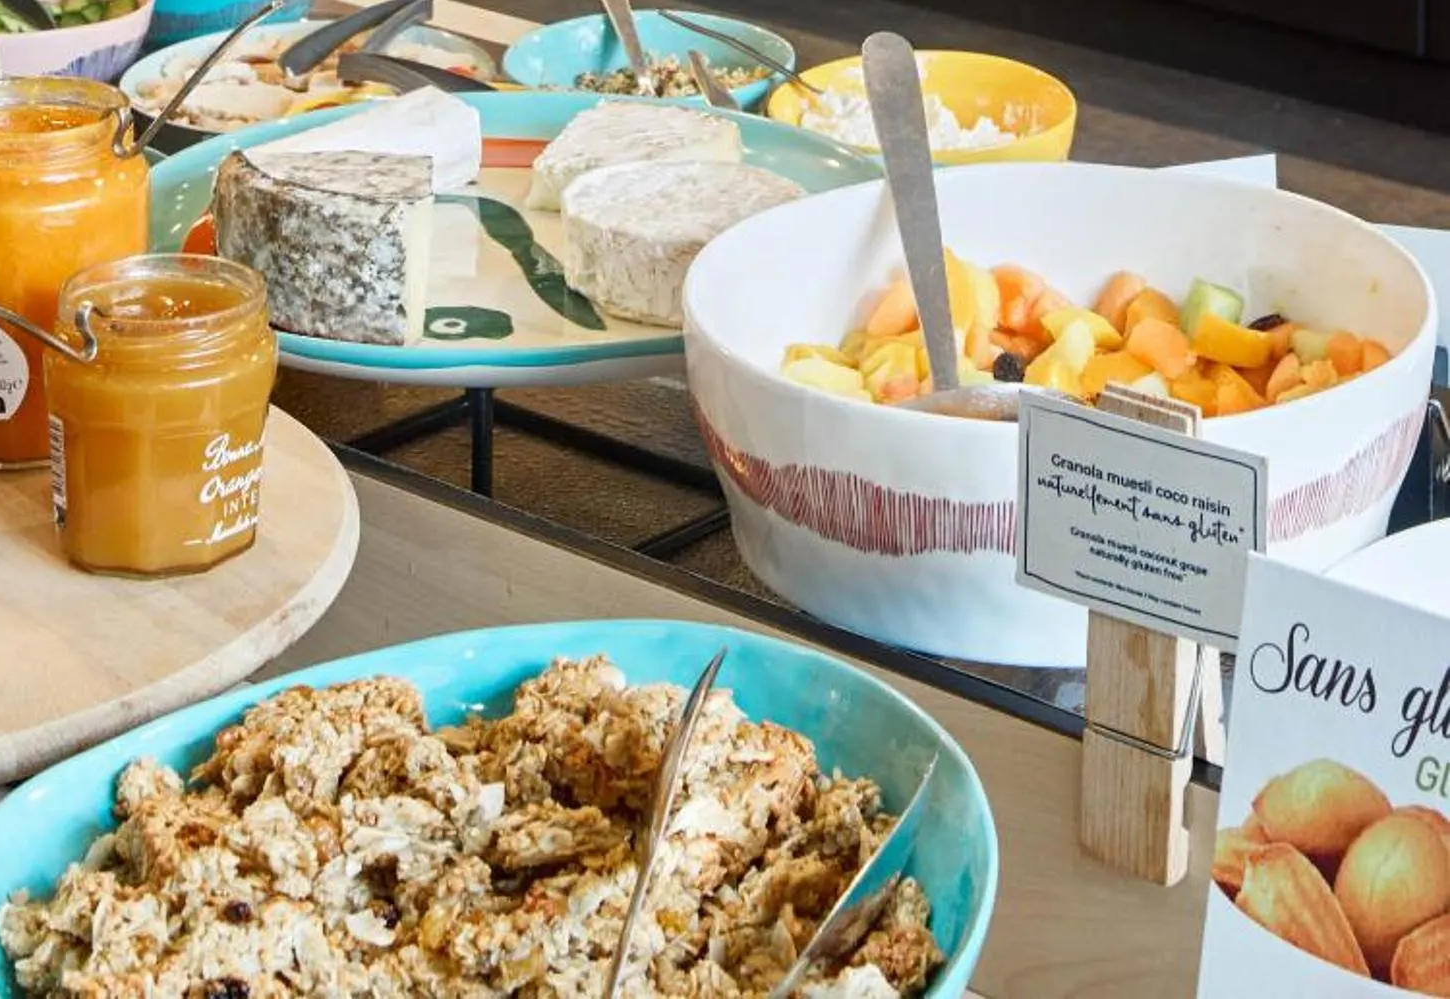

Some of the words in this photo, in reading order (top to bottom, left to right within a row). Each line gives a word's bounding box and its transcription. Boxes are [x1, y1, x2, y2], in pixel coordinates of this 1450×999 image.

[223, 487, 259, 518] INTE
[1037, 474, 1140, 522] naturellement
[1142, 506, 1185, 527] sans
[1050, 453, 1104, 480] Granola
[1106, 472, 1152, 494] muesli
[1155, 485, 1189, 506] coco
[1191, 497, 1231, 517] raisin
[1070, 526, 1105, 544] Granola
[1250, 622, 1377, 714] Sans
